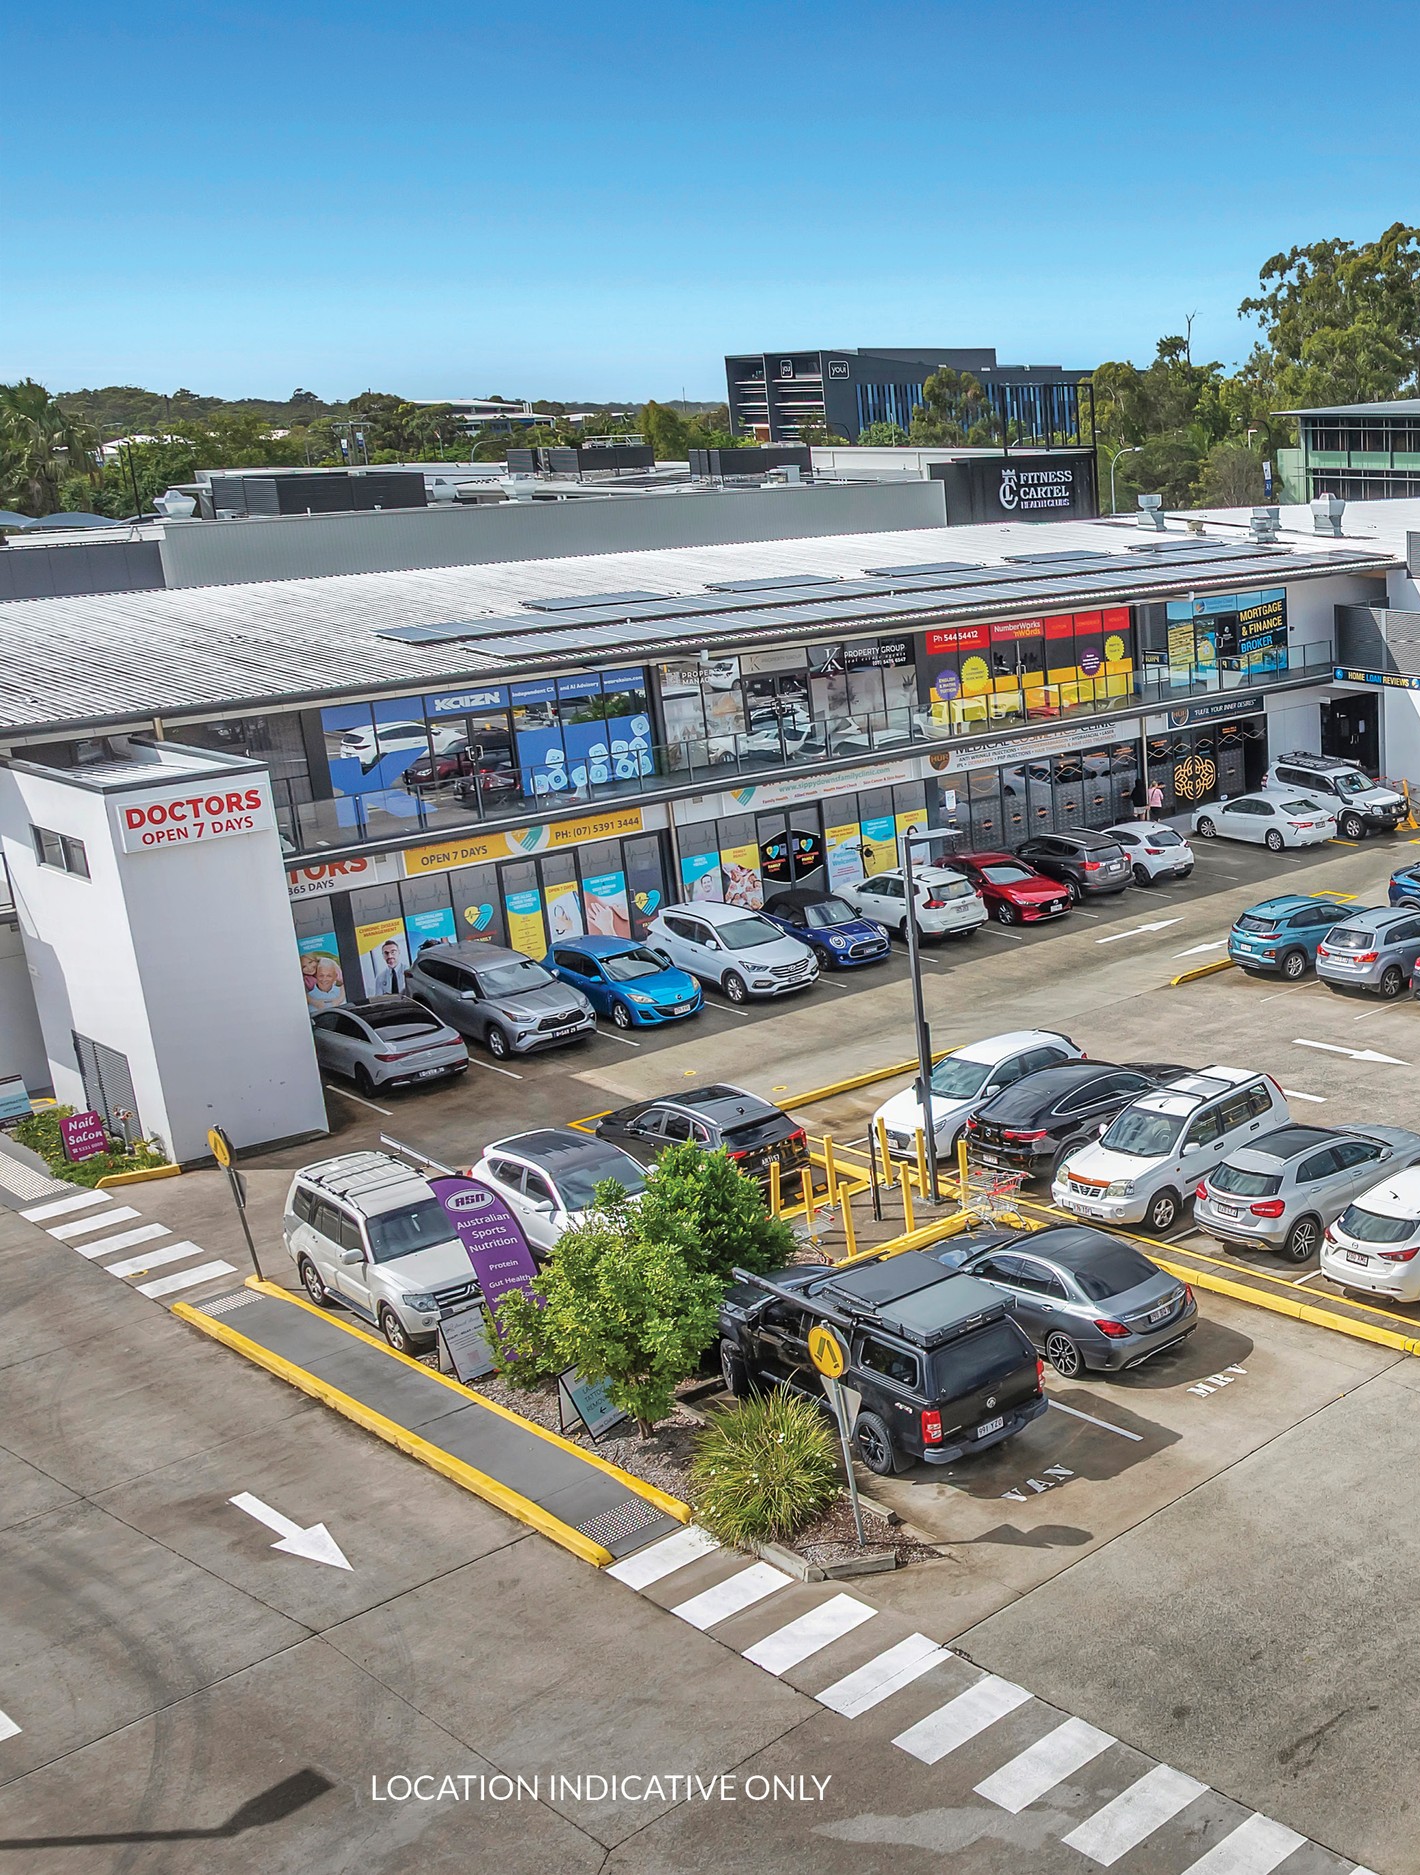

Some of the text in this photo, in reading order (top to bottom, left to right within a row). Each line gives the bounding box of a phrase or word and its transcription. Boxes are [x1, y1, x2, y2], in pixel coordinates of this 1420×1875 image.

[831, 363, 846, 376] youi
[1020, 470, 1073, 484] FITNESS
[1020, 486, 1069, 499] CARTEL
[1240, 601, 1283, 622] MORTGAGE
[994, 621, 1040, 632] NumberWorks
[1241, 615, 1283, 636] & FINANCE
[933, 635, 943, 643] Ph
[1241, 635, 1273, 653] BROKER
[844, 647, 880, 658] PROPERTY
[881, 644, 905, 654] GROUP
[1348, 671, 1366, 681] HOME
[1366, 674, 1382, 683] LOAN
[1382, 676, 1410, 688] REVIEWS
[511, 688, 546, 698] Independent
[1223, 703, 1237, 711] INNER
[931, 754, 949, 763] HUR
[968, 757, 994, 767] DERMAPEN
[1006, 750, 1031, 759] INJECTIONS
[971, 752, 992, 761] WRINKLE
[992, 748, 1017, 757] INJECTIONS
[779, 766, 891, 793] www.sippydownsfamilyclinic.com
[125, 789, 262, 829] DOCTORS
[142, 816, 254, 846] OPEN 7 DAYS
[555, 817, 639, 840] PH: (07) 5391 3444
[421, 845, 488, 866] OPEN 7 DAYS
[308, 879, 335, 892] DAYS
[358, 921, 400, 934] CHRONIC DISEASE
[363, 926, 397, 937] MANAGEMENT
[68, 1115, 95, 1131] Nail
[68, 1130, 103, 1145] Salon
[455, 1193, 485, 1207] ASN
[456, 1212, 511, 1231] Australian
[472, 1225, 507, 1240] Sports
[469, 1235, 518, 1254] Nutrition
[489, 1259, 519, 1271] Protein
[489, 1275, 531, 1289] Gut Health
[1186, 1363, 1250, 1398] MRV
[584, 1388, 605, 1402] TATTO
[586, 1397, 606, 1412] REMOV
[979, 1425, 990, 1436] 991
[1001, 1463, 1075, 1502] VAN
